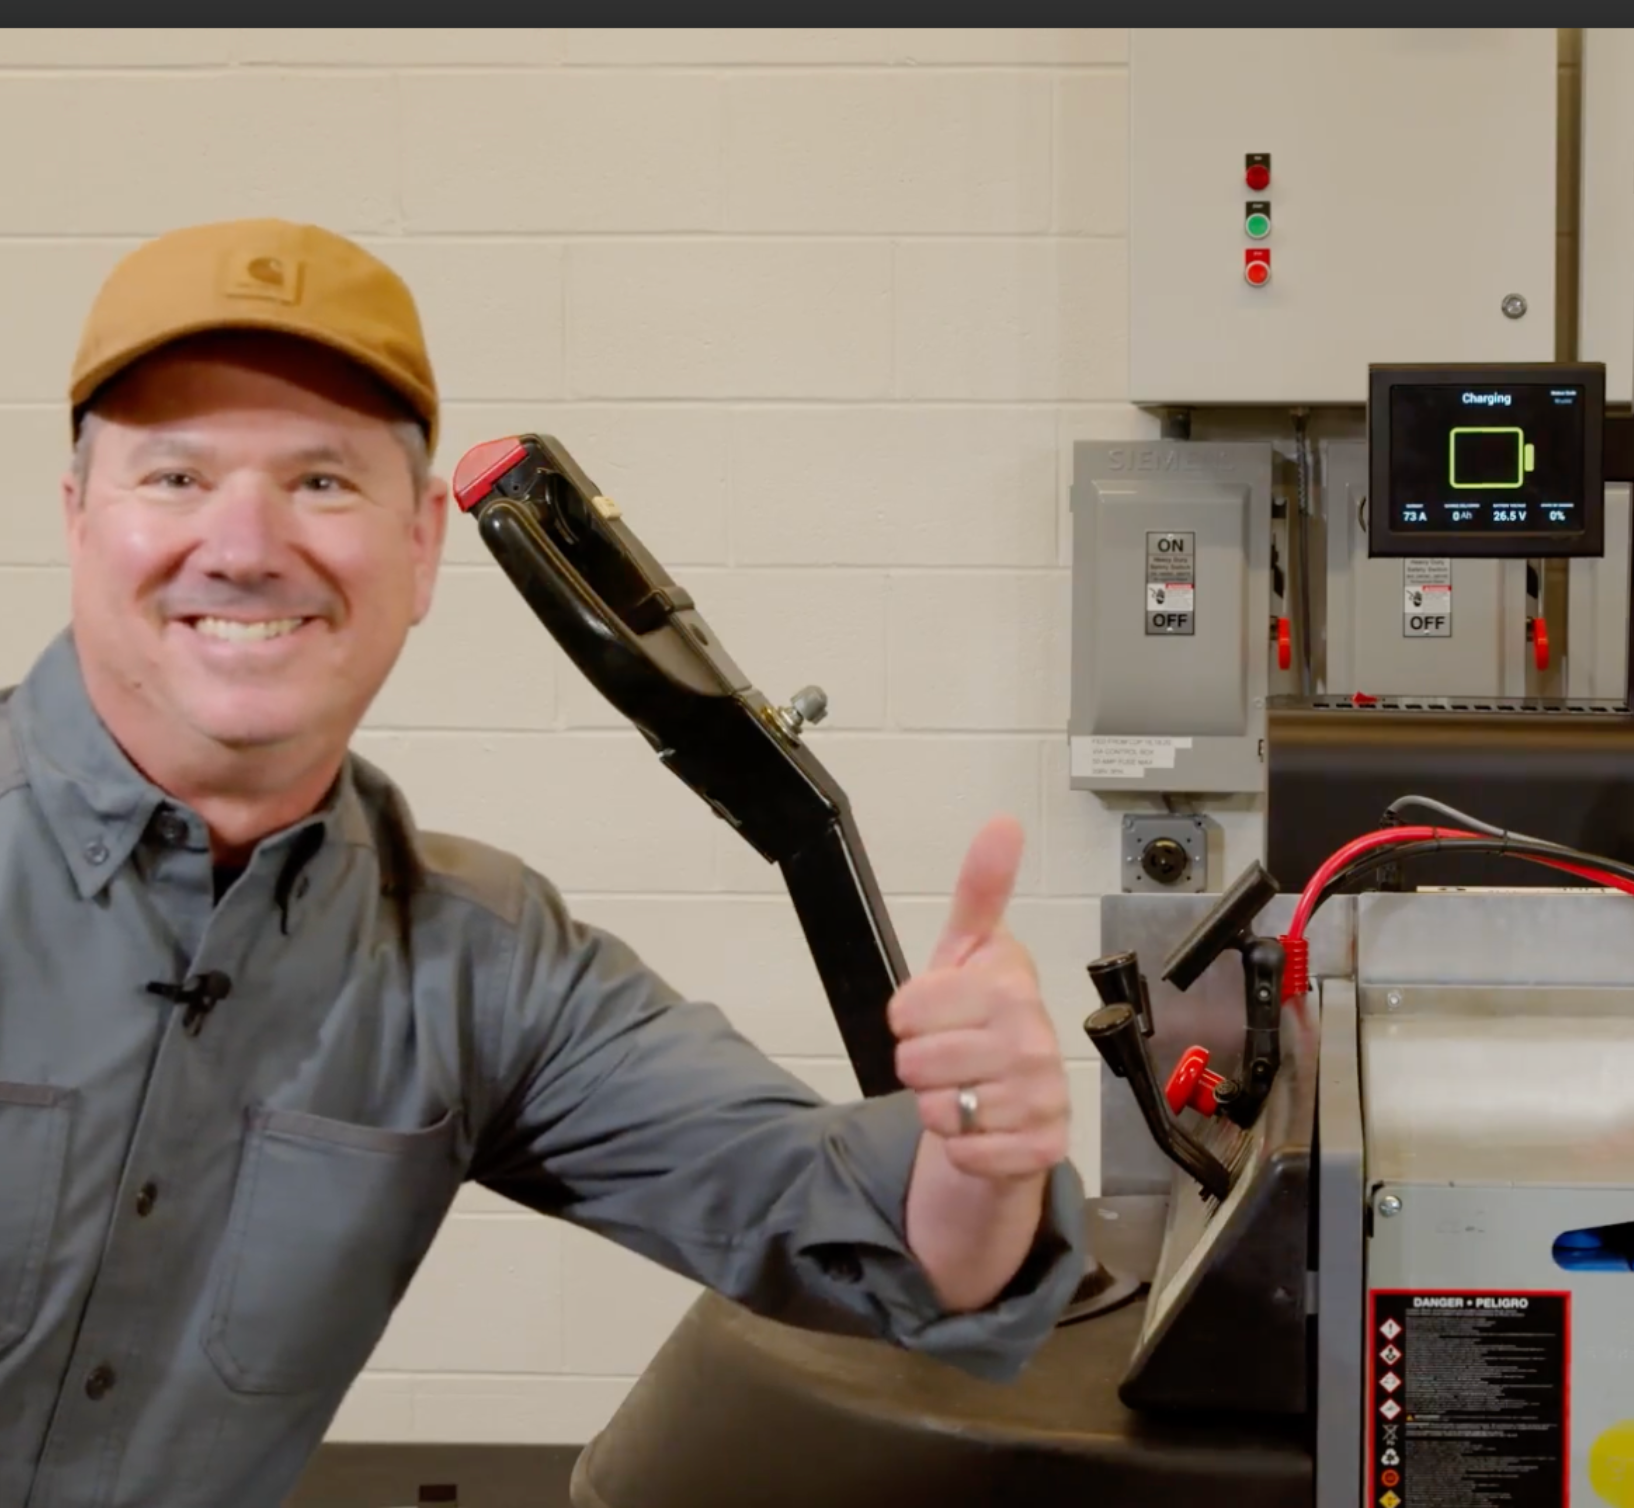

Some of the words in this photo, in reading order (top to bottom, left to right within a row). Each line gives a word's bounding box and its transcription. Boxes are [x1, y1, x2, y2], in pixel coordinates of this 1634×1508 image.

[1461, 391, 1512, 406] Charging
[1403, 511, 1417, 521] 73
[1418, 511, 1428, 521] A
[1452, 511, 1460, 521] 0
[1493, 511, 1517, 521] 26.5
[1518, 511, 1527, 521] V
[1549, 511, 1565, 521] 0%
[1157, 539, 1184, 553] ON
[1152, 613, 1188, 628] OFF
[1410, 615, 1446, 630] OFF
[1413, 1297, 1464, 1309] DANGER
[1475, 1297, 1529, 1309] PELIGRO
